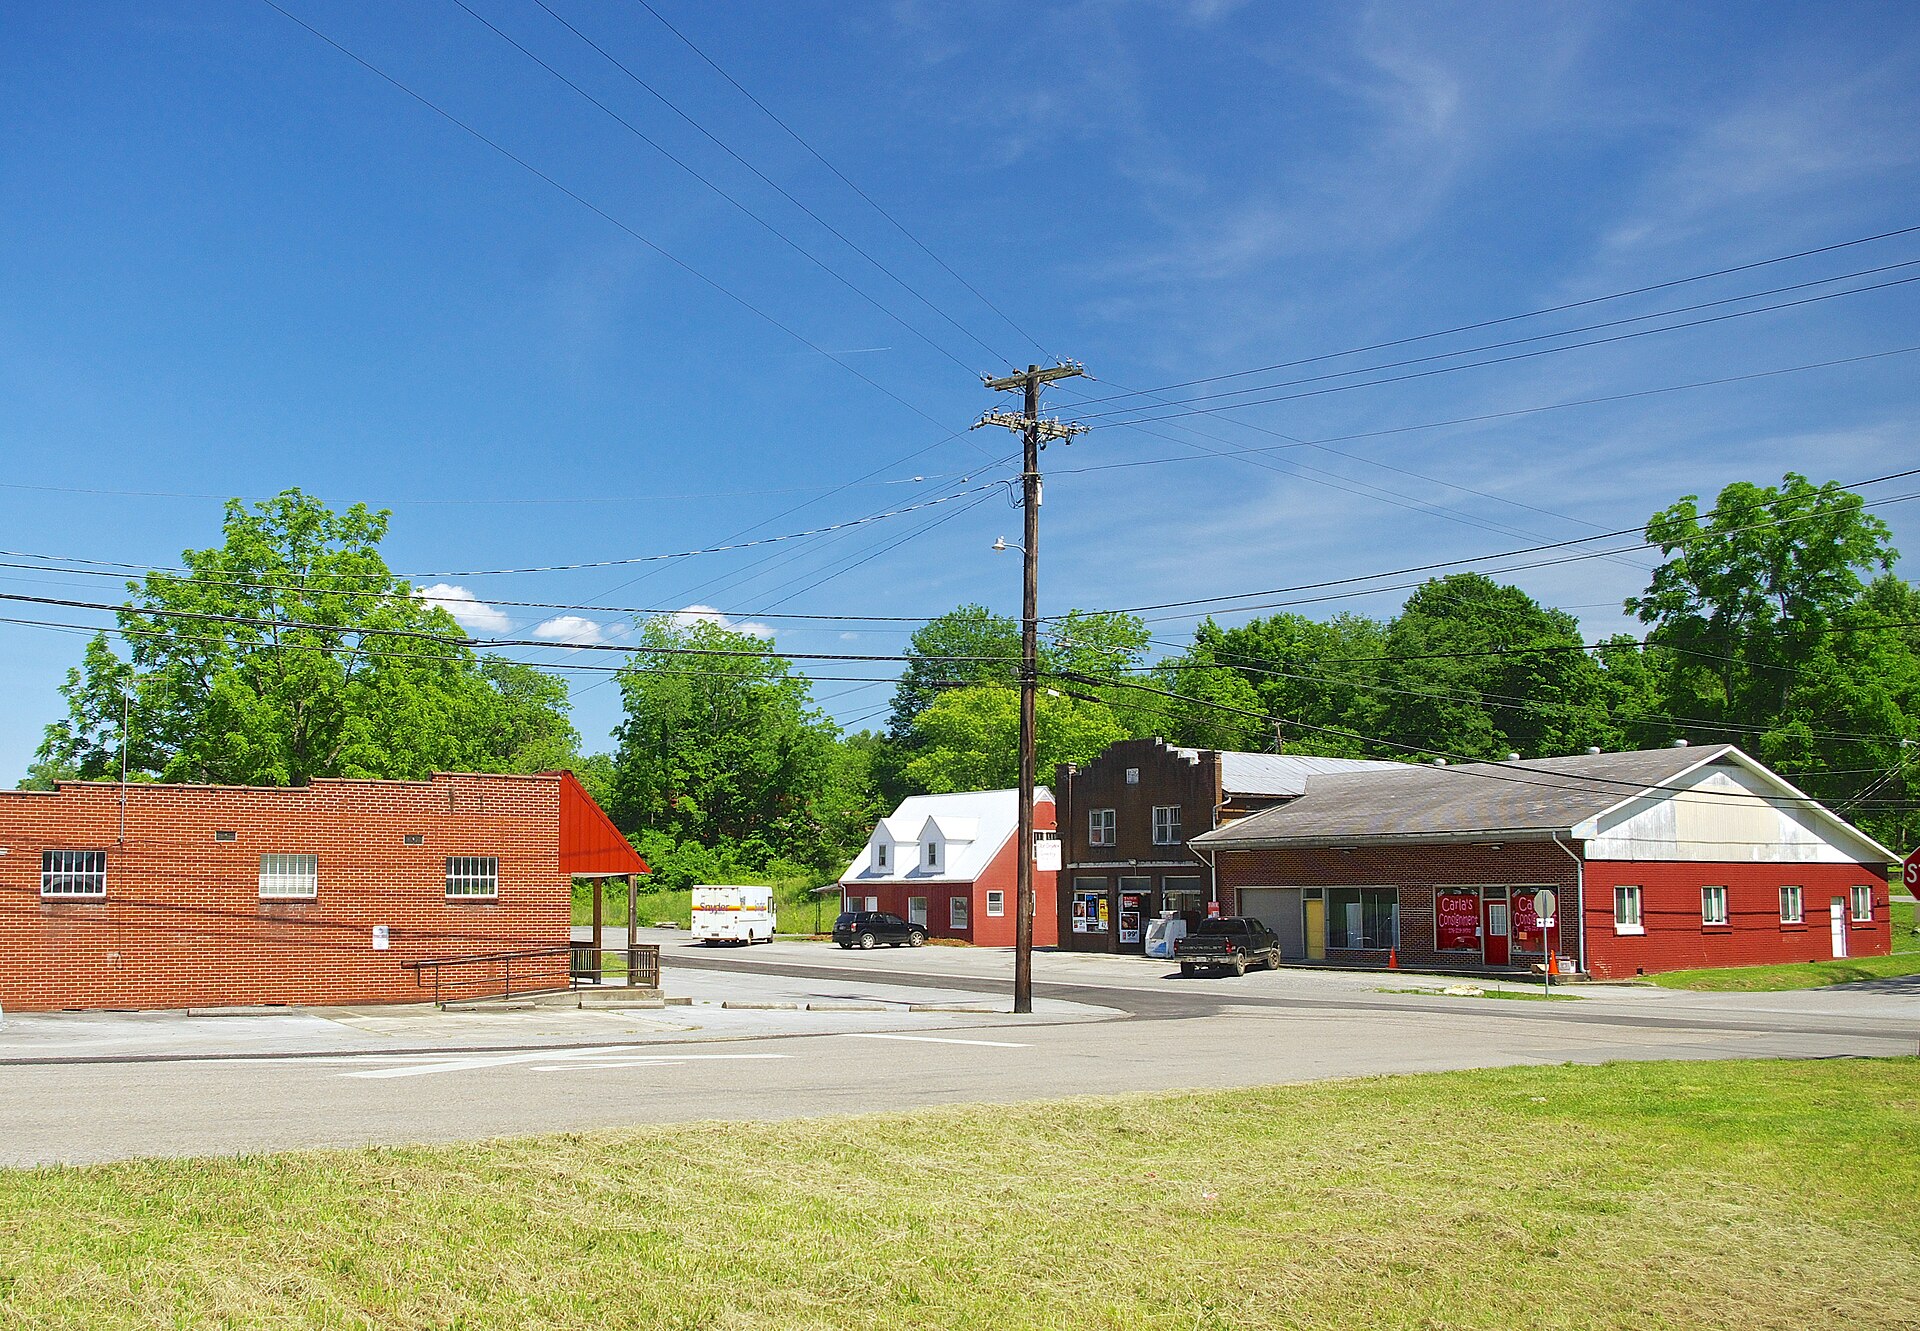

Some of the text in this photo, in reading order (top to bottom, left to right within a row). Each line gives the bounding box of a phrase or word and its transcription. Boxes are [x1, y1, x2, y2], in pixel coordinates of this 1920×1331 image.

[700, 902, 730, 914] Snyder
[1442, 898, 1473, 912] Carla's
[1438, 912, 1478, 927] Consignment
